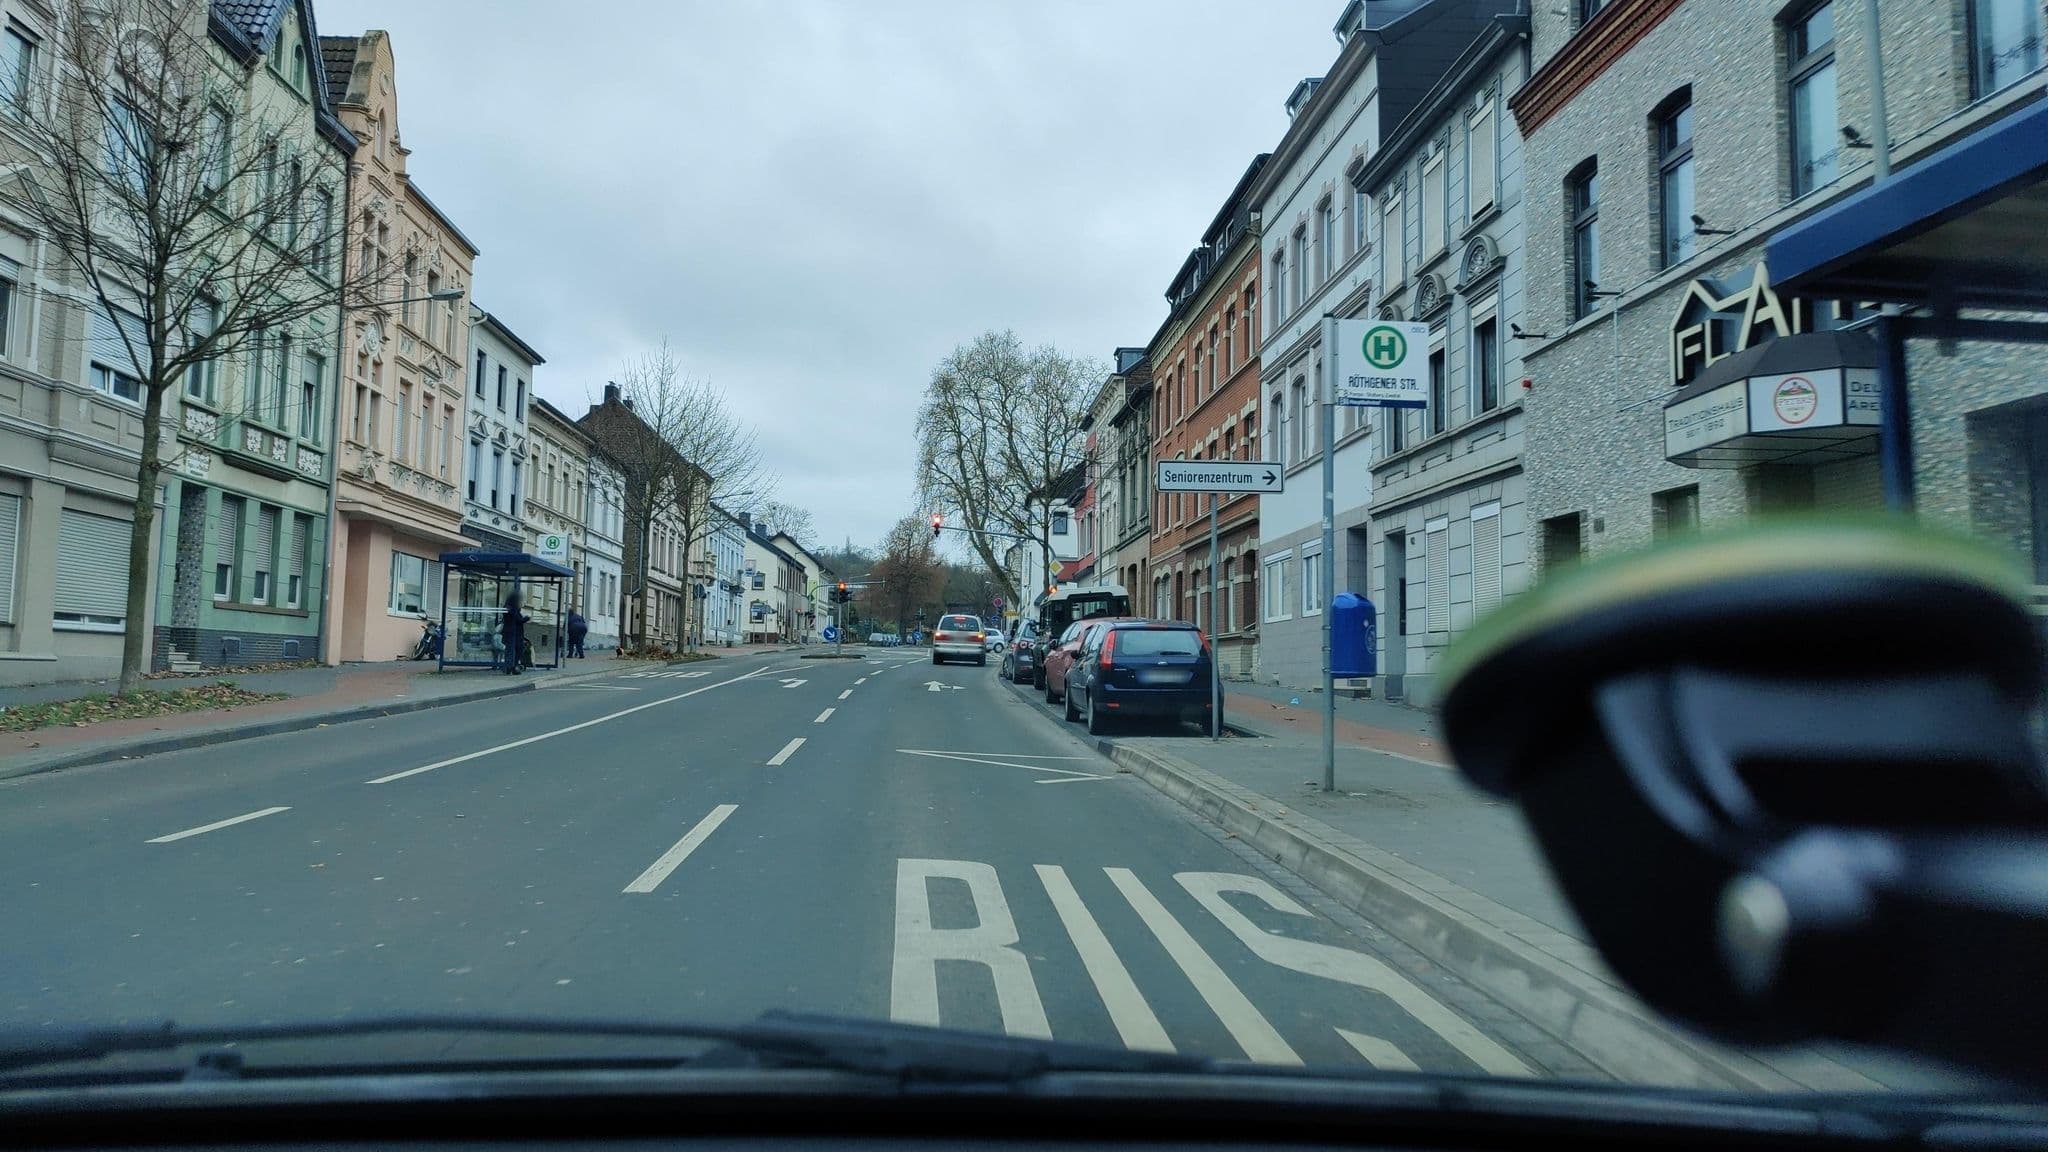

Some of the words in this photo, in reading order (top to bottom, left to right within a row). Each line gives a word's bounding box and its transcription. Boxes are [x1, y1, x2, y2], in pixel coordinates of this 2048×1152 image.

[1348, 374, 1397, 390] RÖTHGENER
[1400, 378, 1420, 390] STR.
[1165, 470, 1253, 484] Seniorenzentrum
